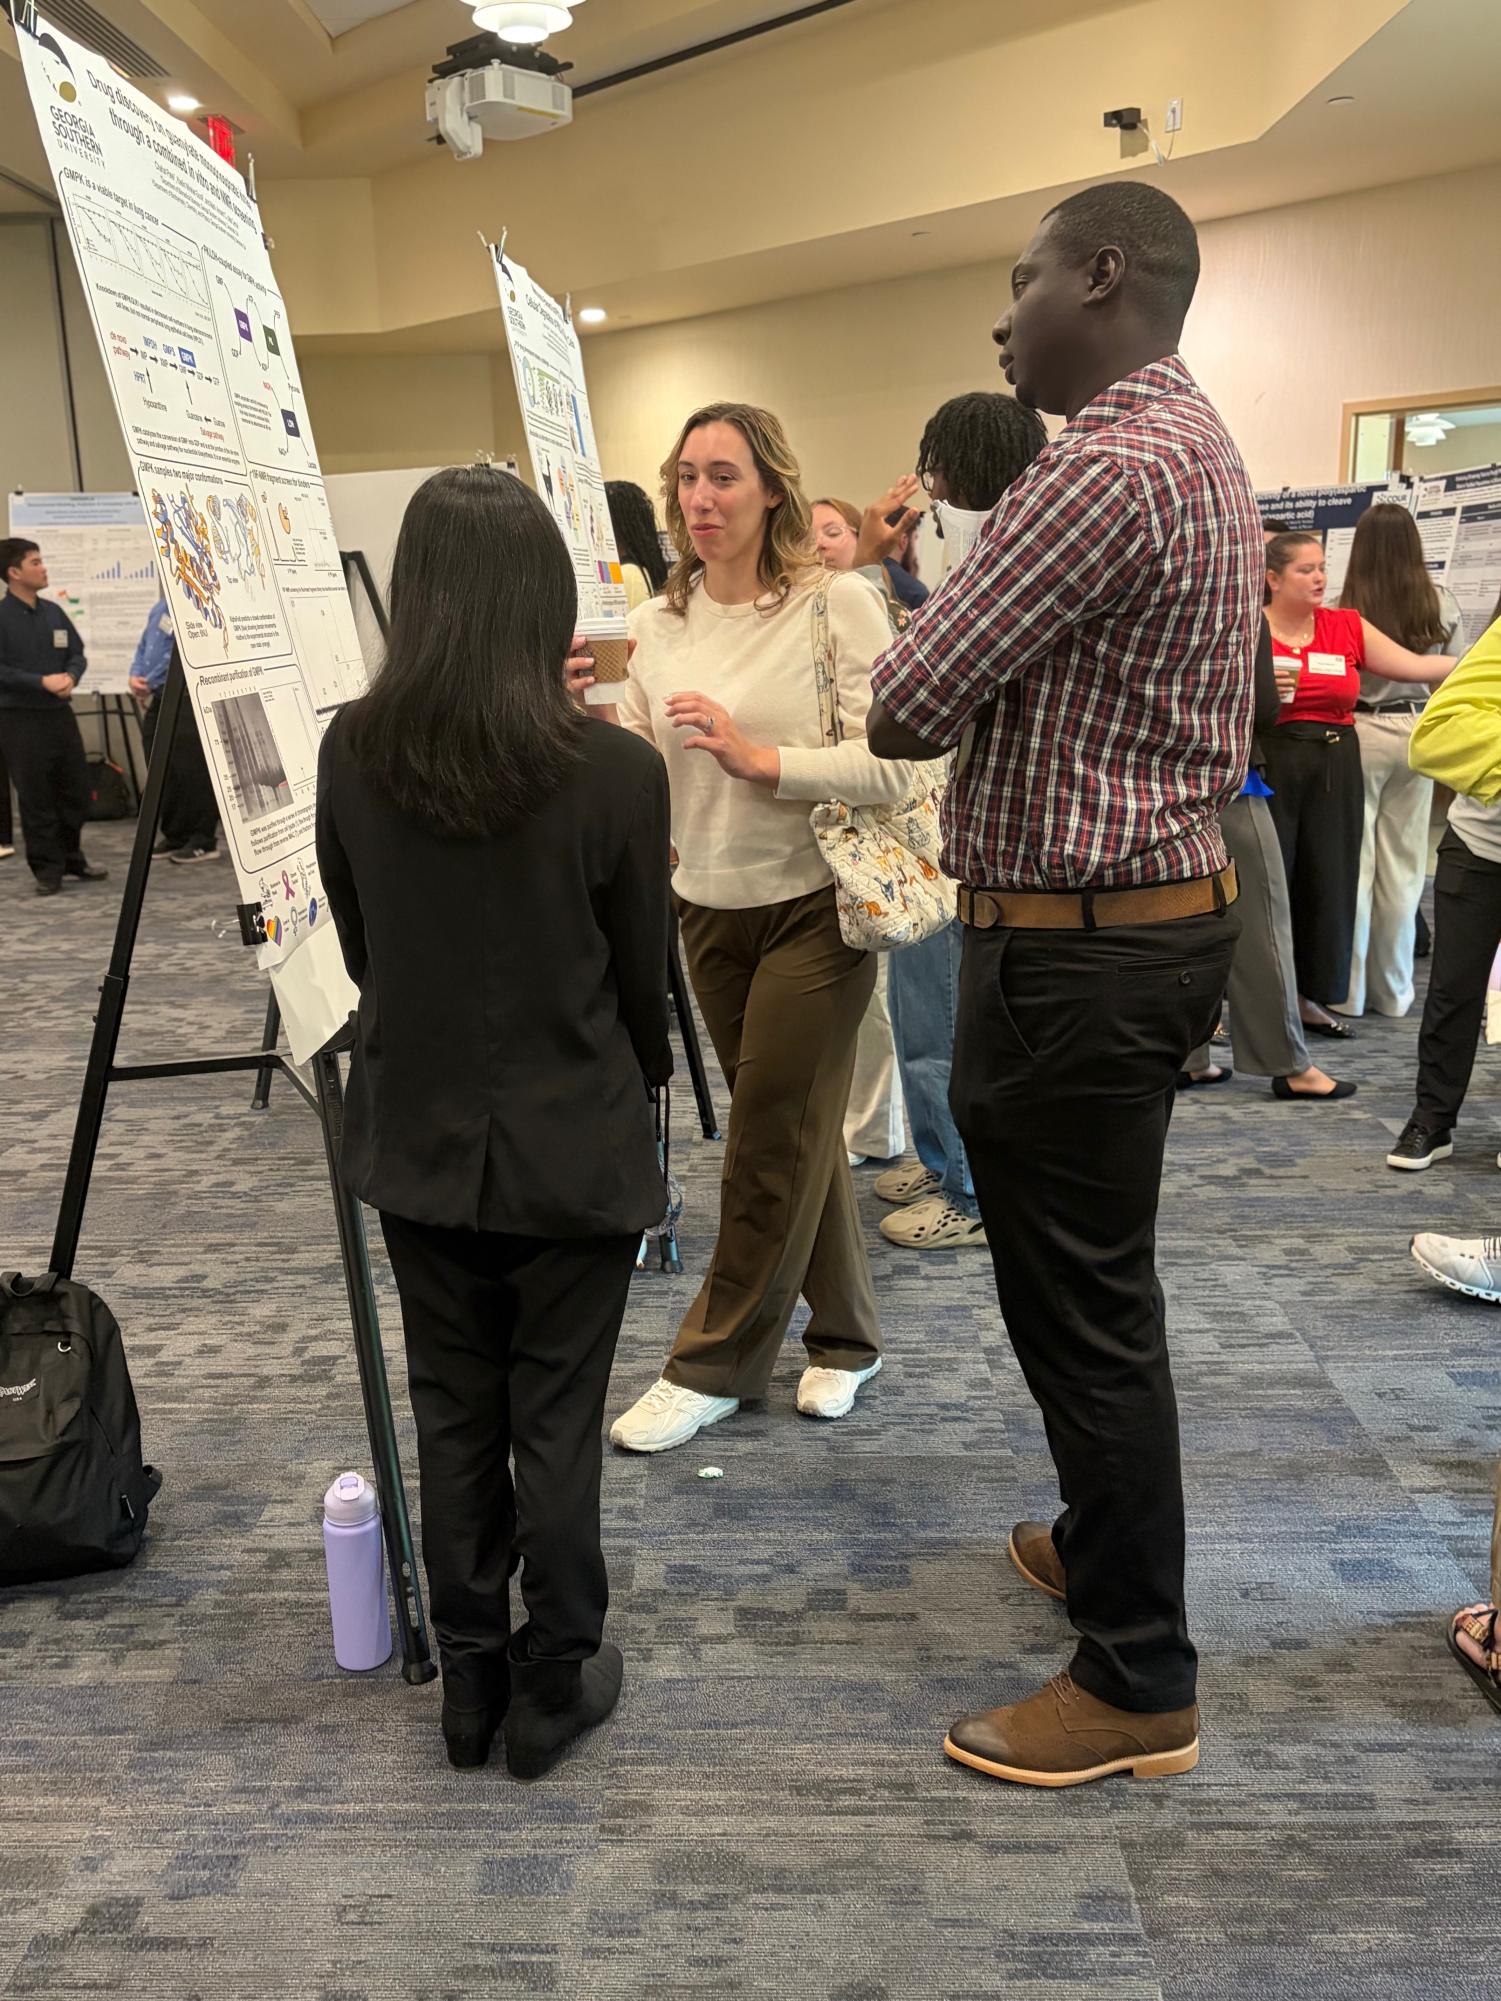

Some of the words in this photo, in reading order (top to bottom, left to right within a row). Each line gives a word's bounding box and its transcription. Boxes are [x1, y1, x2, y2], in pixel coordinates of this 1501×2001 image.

[86, 69, 116, 105] Drug
[115, 87, 156, 132] discovery
[50, 105, 96, 139] GEORGIA
[52, 120, 103, 157] SOUTHERN
[57, 138, 106, 170] UNIVERSITY
[109, 107, 145, 146] through
[145, 134, 152, 149] a
[152, 139, 188, 174] combined
[63, 167, 85, 184] GMPK
[1270, 501, 1284, 510] and
[1294, 499, 1317, 509] ability
[1317, 499, 1326, 507] to
[1327, 497, 1352, 506] cleave
[185, 621, 195, 630] Side
[199, 673, 229, 686] Recombinant
